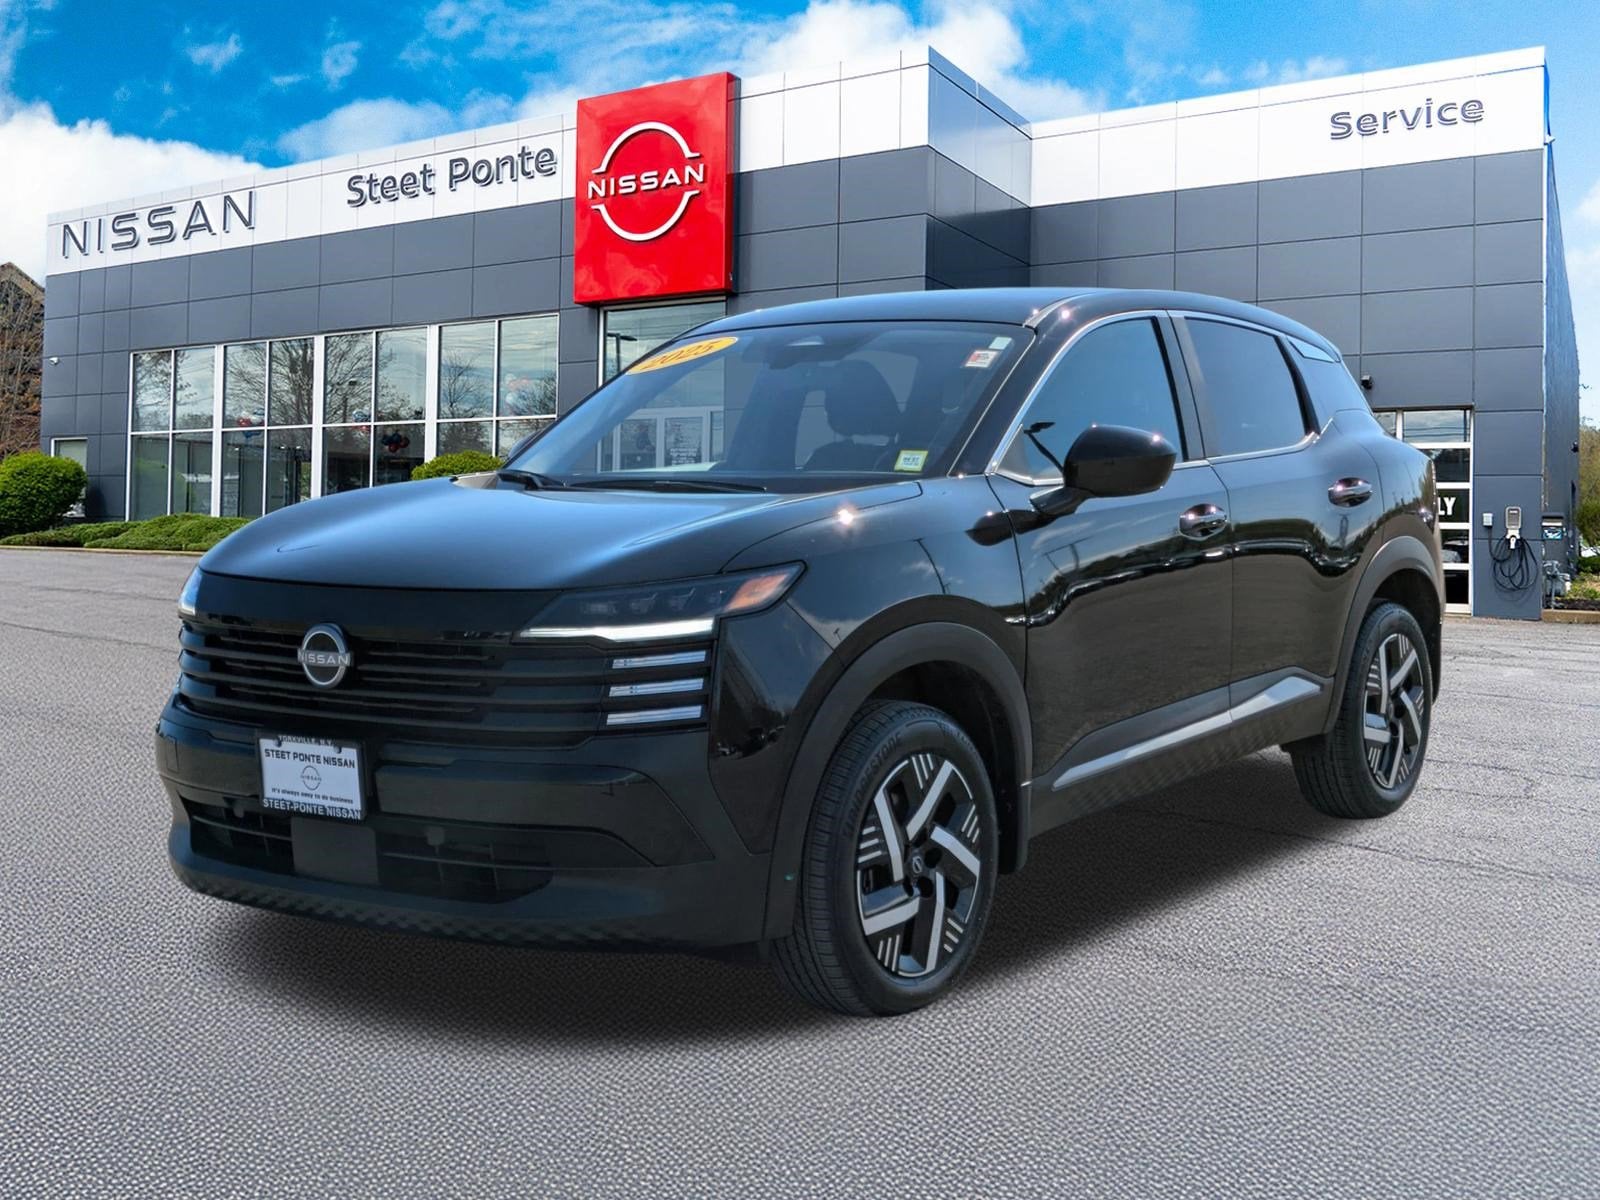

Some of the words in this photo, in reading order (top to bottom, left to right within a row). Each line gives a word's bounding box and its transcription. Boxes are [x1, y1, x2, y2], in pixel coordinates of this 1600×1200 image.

[1329, 97, 1484, 140] Service
[347, 163, 436, 208] Steet
[449, 145, 557, 191] Ponte
[587, 163, 705, 200] NISSAN
[62, 190, 256, 259] NISSAN
[297, 648, 350, 666] NISSAN
[264, 748, 290, 760] STEET
[293, 752, 321, 764] PONTE
[323, 757, 355, 768] NISSAN
[263, 798, 325, 815] STEET-PONTE
[326, 807, 361, 820] NISSAN
